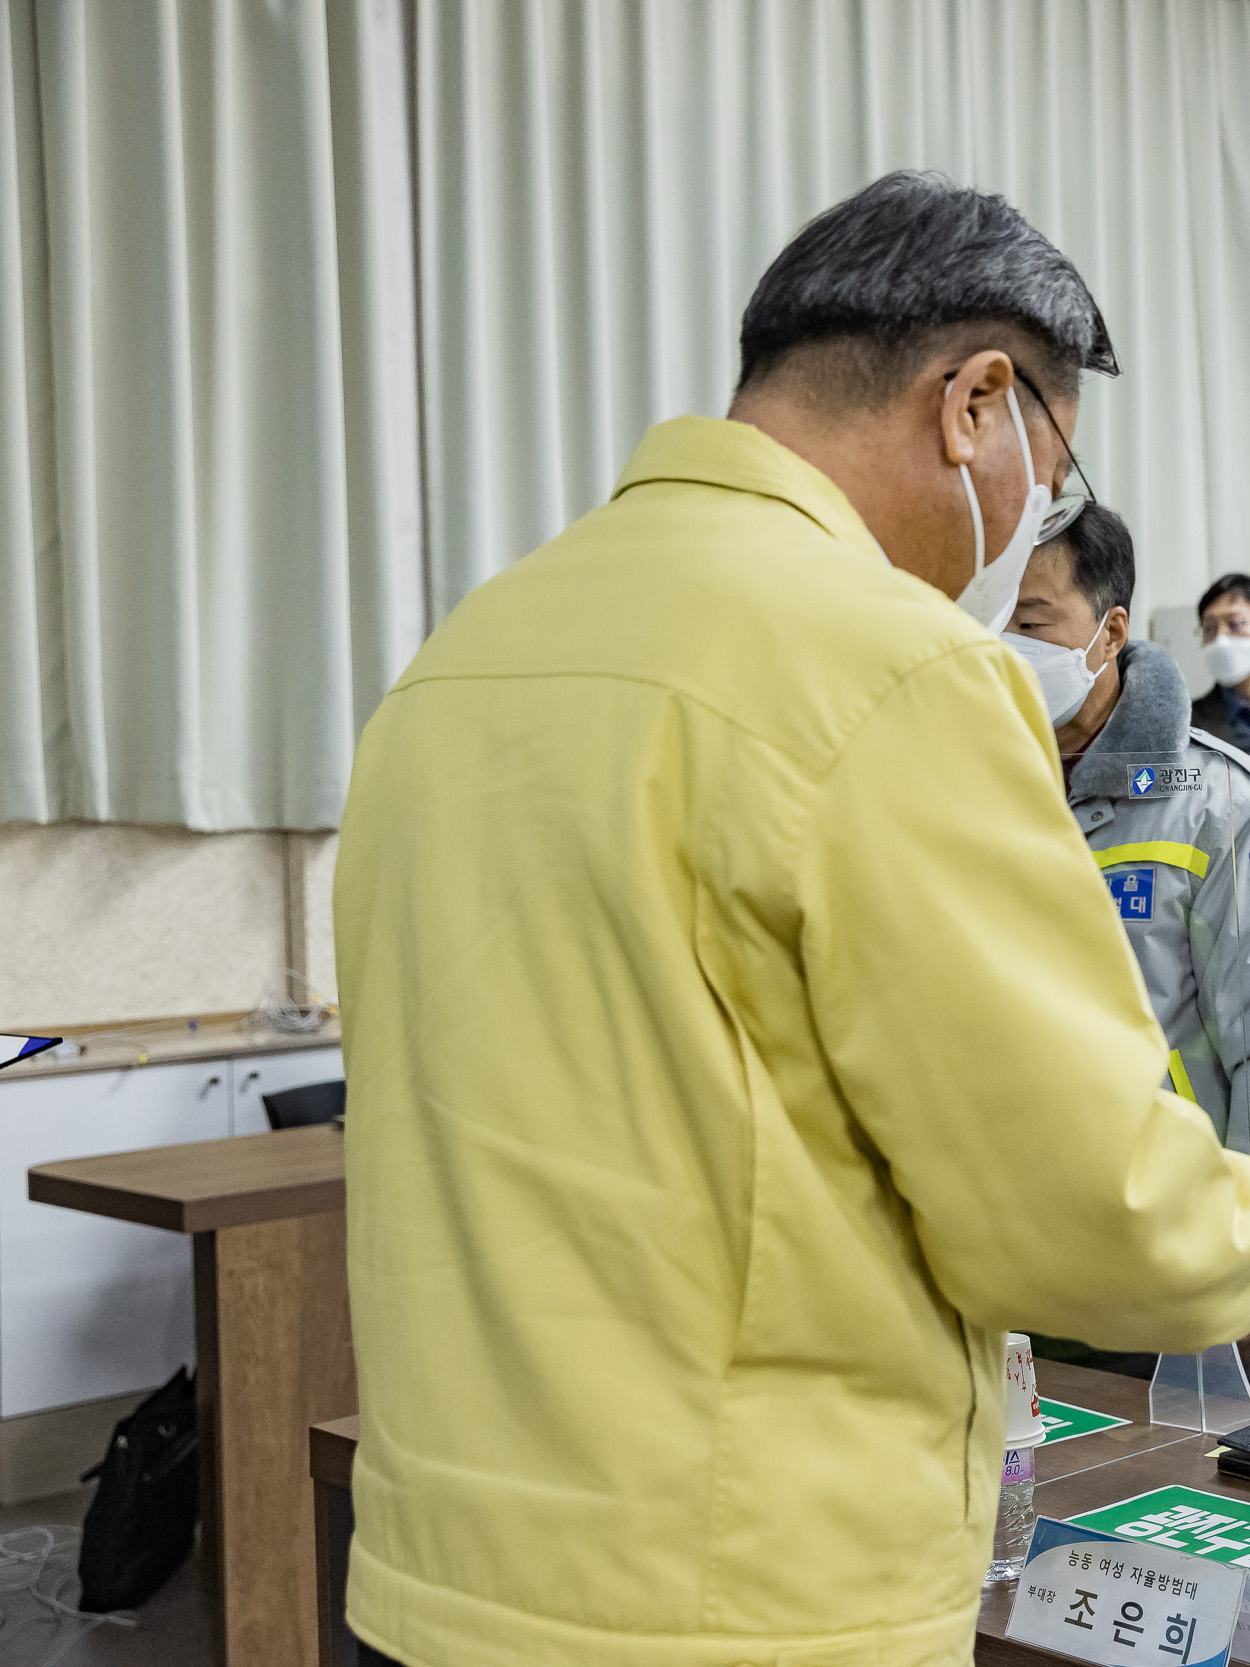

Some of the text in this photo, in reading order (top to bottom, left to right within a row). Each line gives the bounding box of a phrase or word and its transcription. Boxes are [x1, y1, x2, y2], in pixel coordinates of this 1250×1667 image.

[1160, 767, 1202, 785] 광진구
[1005, 1464, 1020, 1476] 8.0
[1068, 1550, 1199, 1601] 능동 여성 자율방범대
[1027, 1584, 1057, 1604] 부대장
